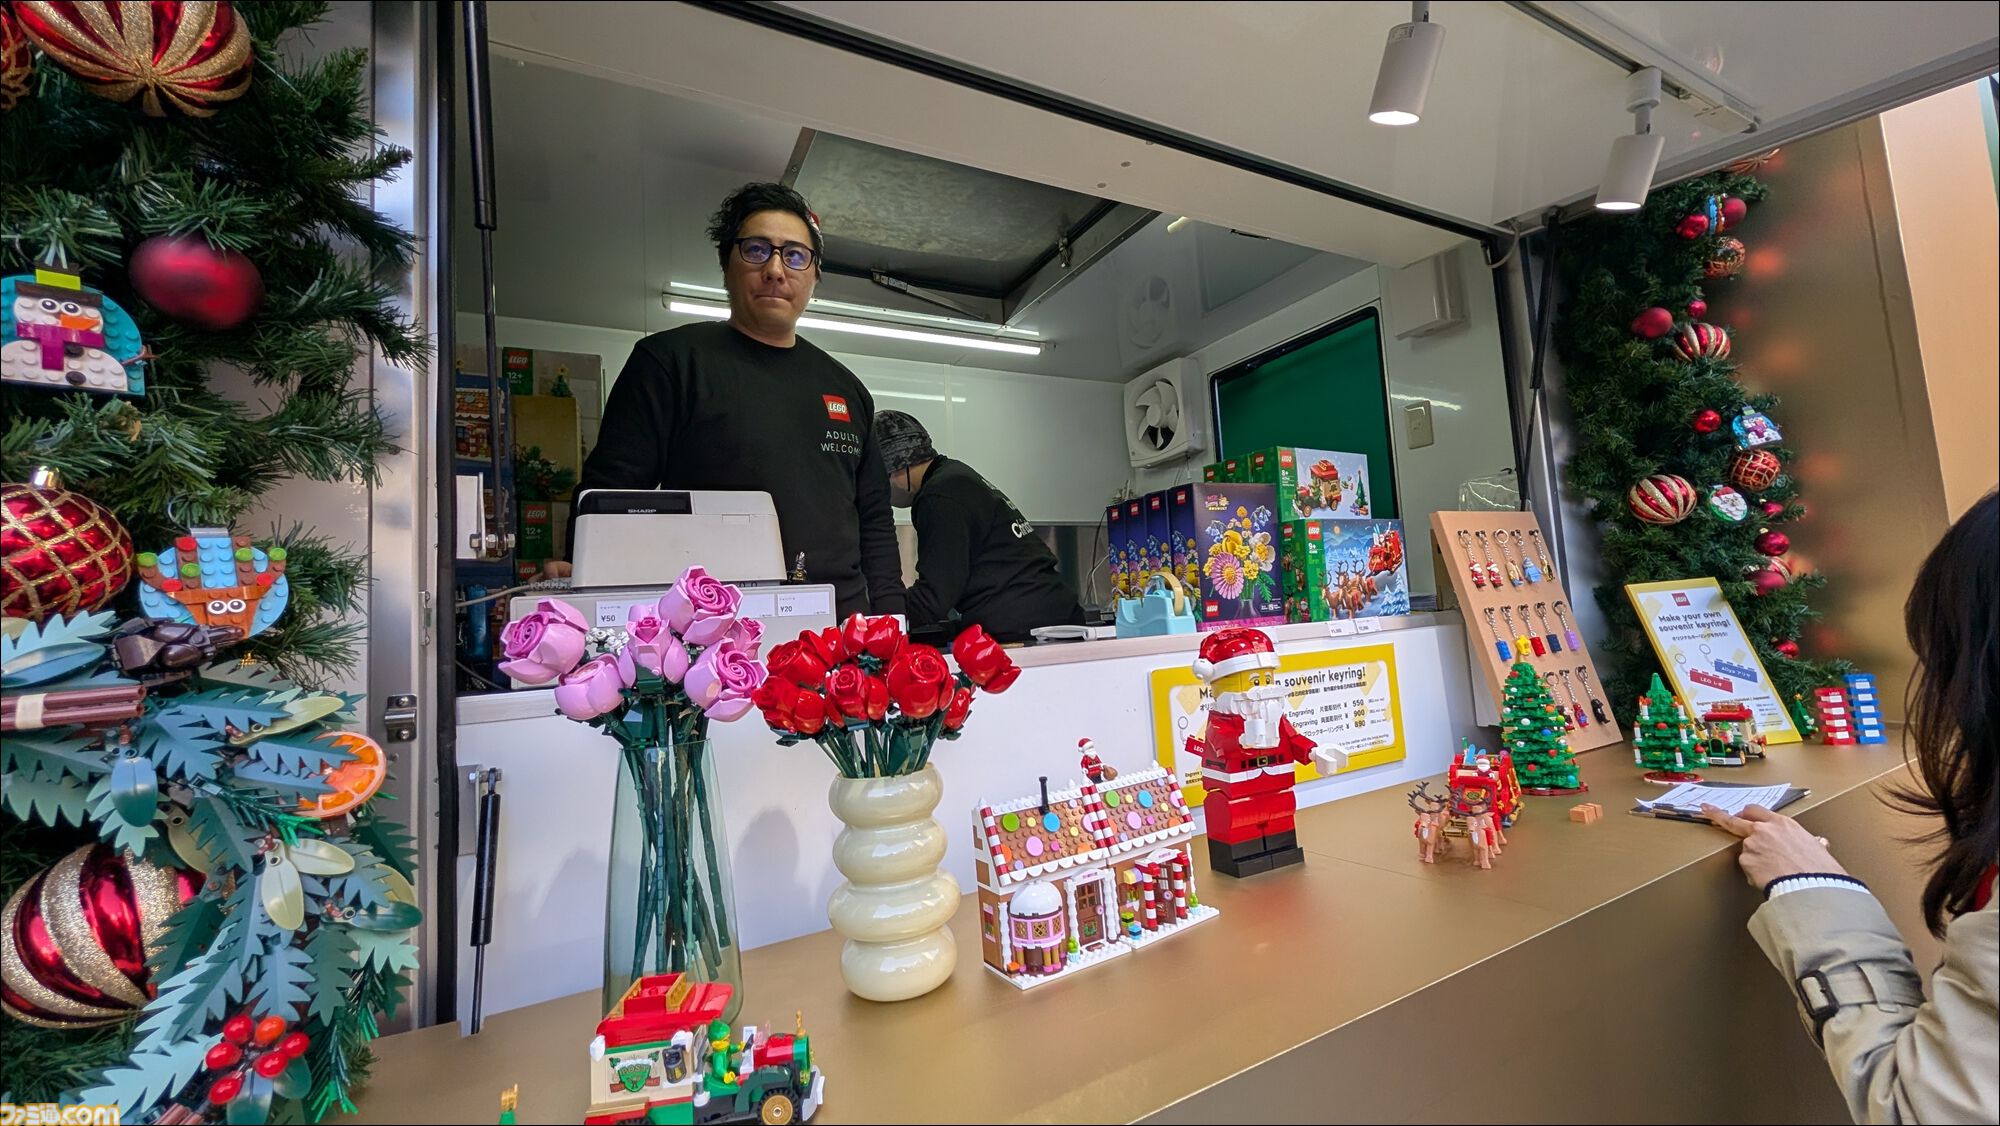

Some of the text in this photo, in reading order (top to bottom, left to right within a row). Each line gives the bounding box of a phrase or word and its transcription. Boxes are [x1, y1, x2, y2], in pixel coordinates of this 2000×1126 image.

[828, 401, 847, 414] LEGO
[820, 443, 861, 456] WELCOM
[601, 614, 616, 622] ¥50
[1658, 613, 1681, 622] Make
[1682, 613, 1701, 621] your
[1659, 619, 1731, 632] souvenir keyring!
[1284, 671, 1326, 687] souvenir
[1328, 666, 1366, 683] keyring!
[1289, 708, 1315, 718] Engraving
[1352, 699, 1364, 708] 550
[1293, 719, 1318, 728] Engraving
[1353, 709, 1365, 717] 900
